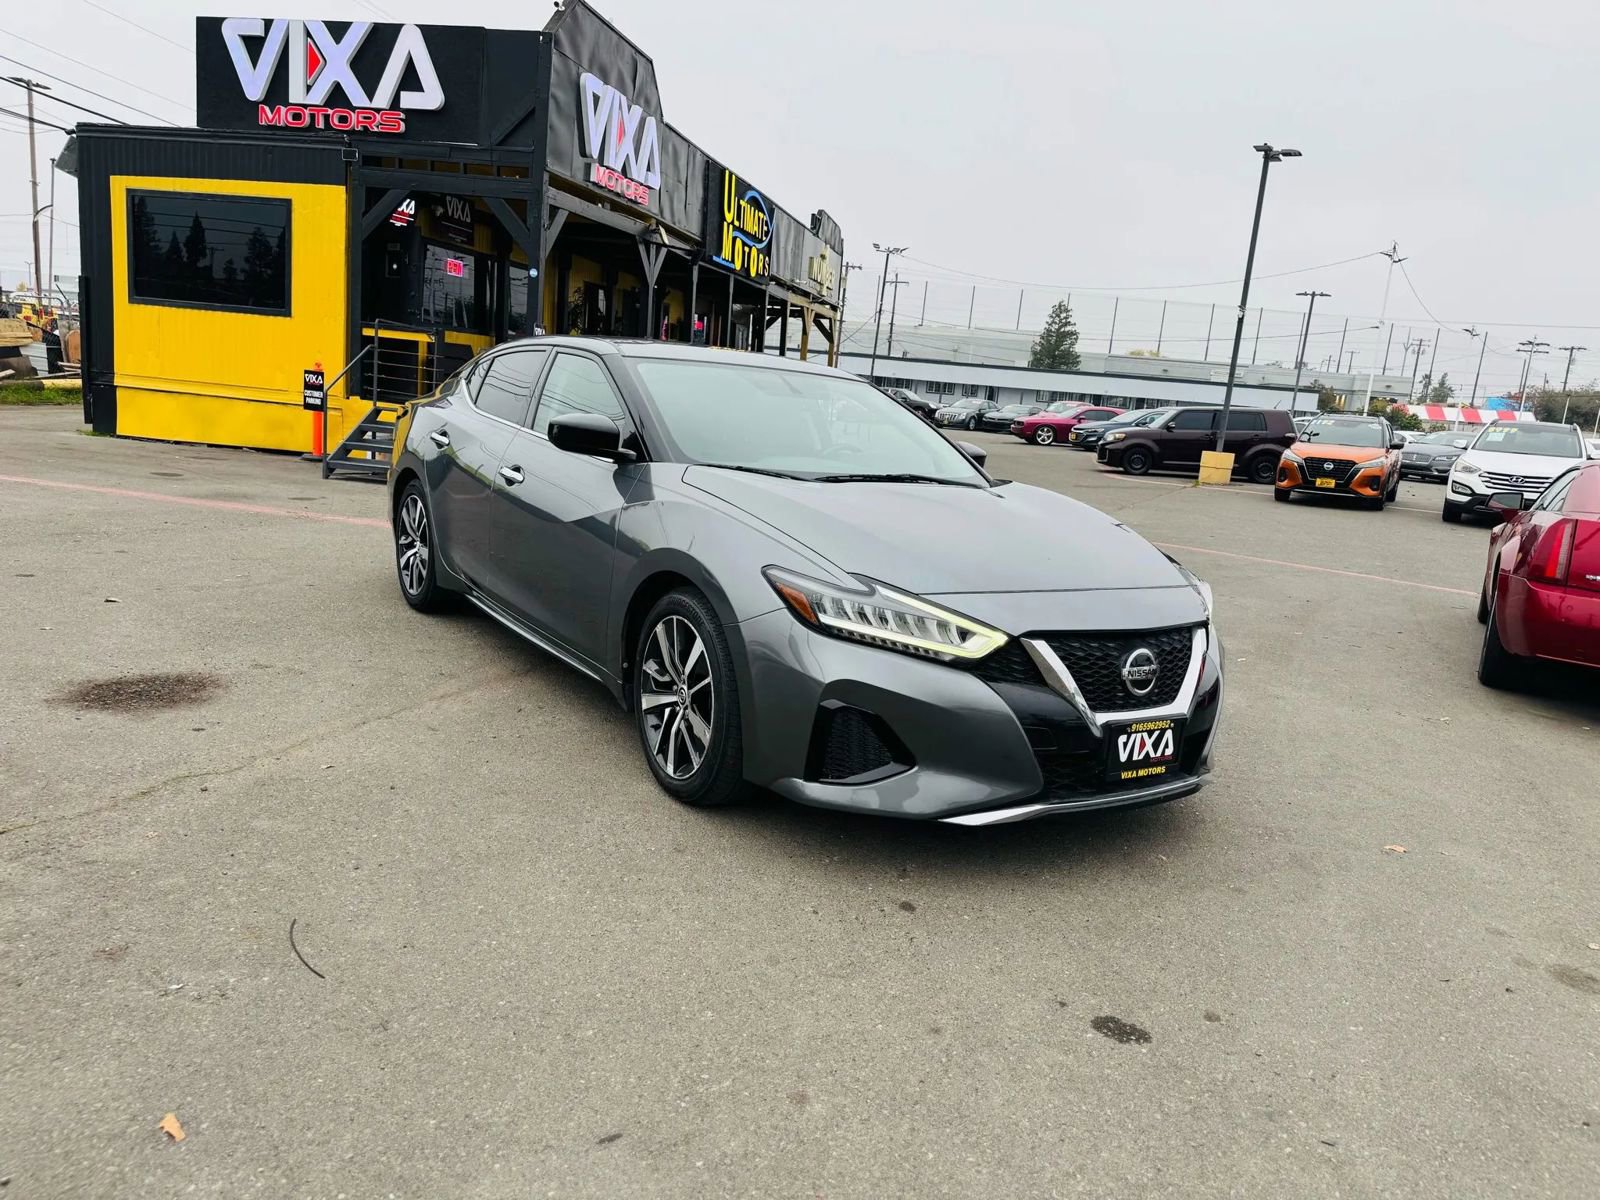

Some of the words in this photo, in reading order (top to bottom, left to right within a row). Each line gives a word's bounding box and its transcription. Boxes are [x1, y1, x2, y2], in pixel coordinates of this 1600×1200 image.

[221, 18, 445, 111] VIXA
[258, 103, 405, 133] MOTORS
[580, 72, 661, 191] VIXA
[593, 162, 649, 206] MOTORS
[446, 195, 471, 223] VIXA
[304, 373, 323, 384] VIXA
[1117, 728, 1175, 763] VIXA
[1121, 770, 1137, 779] VIXA
[1138, 766, 1166, 777] MOTORS
